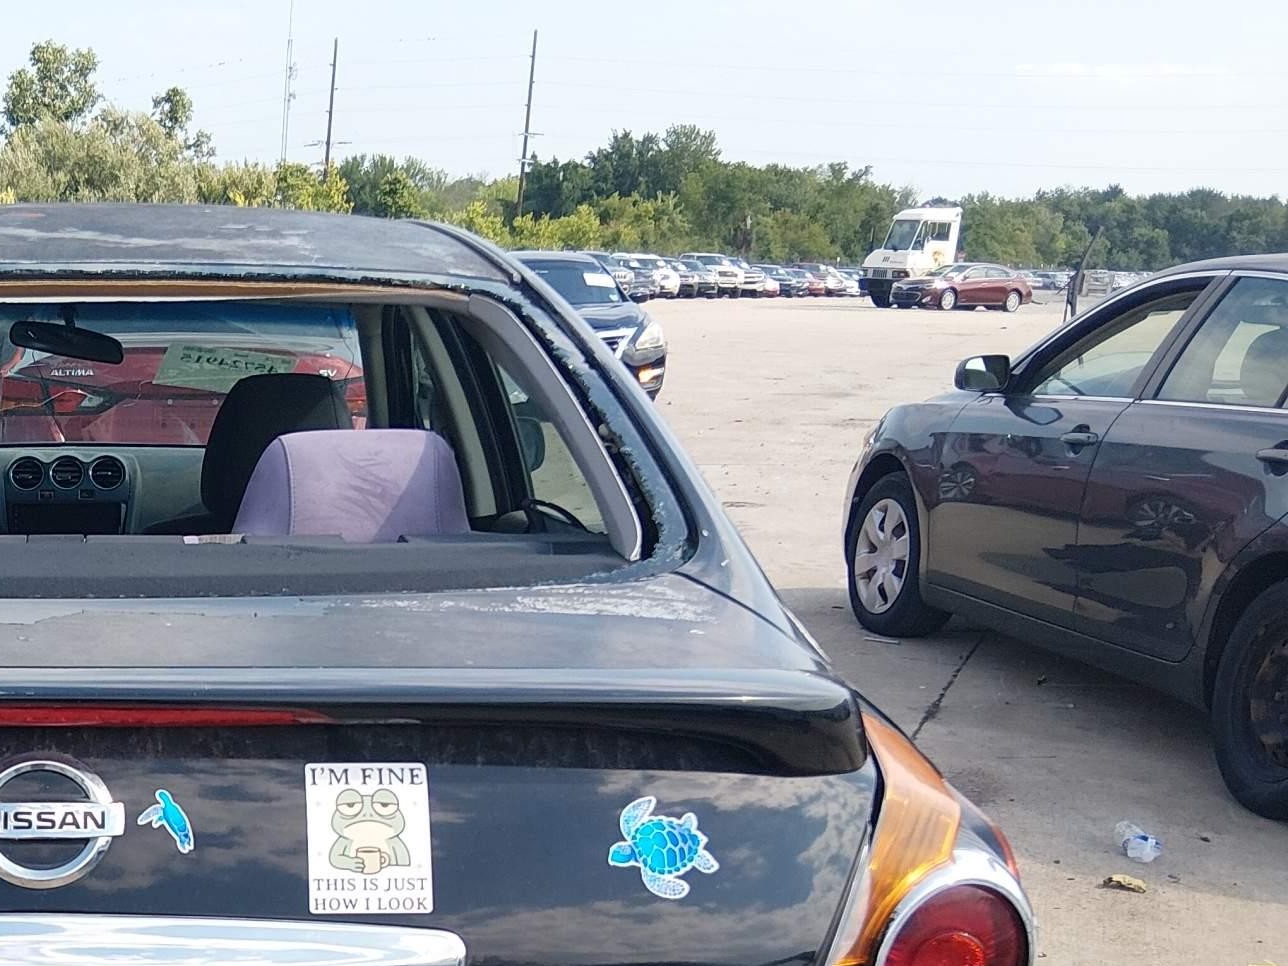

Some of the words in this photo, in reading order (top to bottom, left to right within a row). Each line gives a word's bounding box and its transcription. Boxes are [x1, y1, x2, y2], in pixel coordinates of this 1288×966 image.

[50, 369, 95, 377] ALTIMA
[361, 768, 424, 785] FINE
[313, 878, 357, 892] THIS
[363, 878, 379, 891] IS
[384, 877, 428, 892] JUST
[314, 898, 358, 911] HOW
[365, 897, 371, 911] I
[377, 896, 428, 911] LOOK
